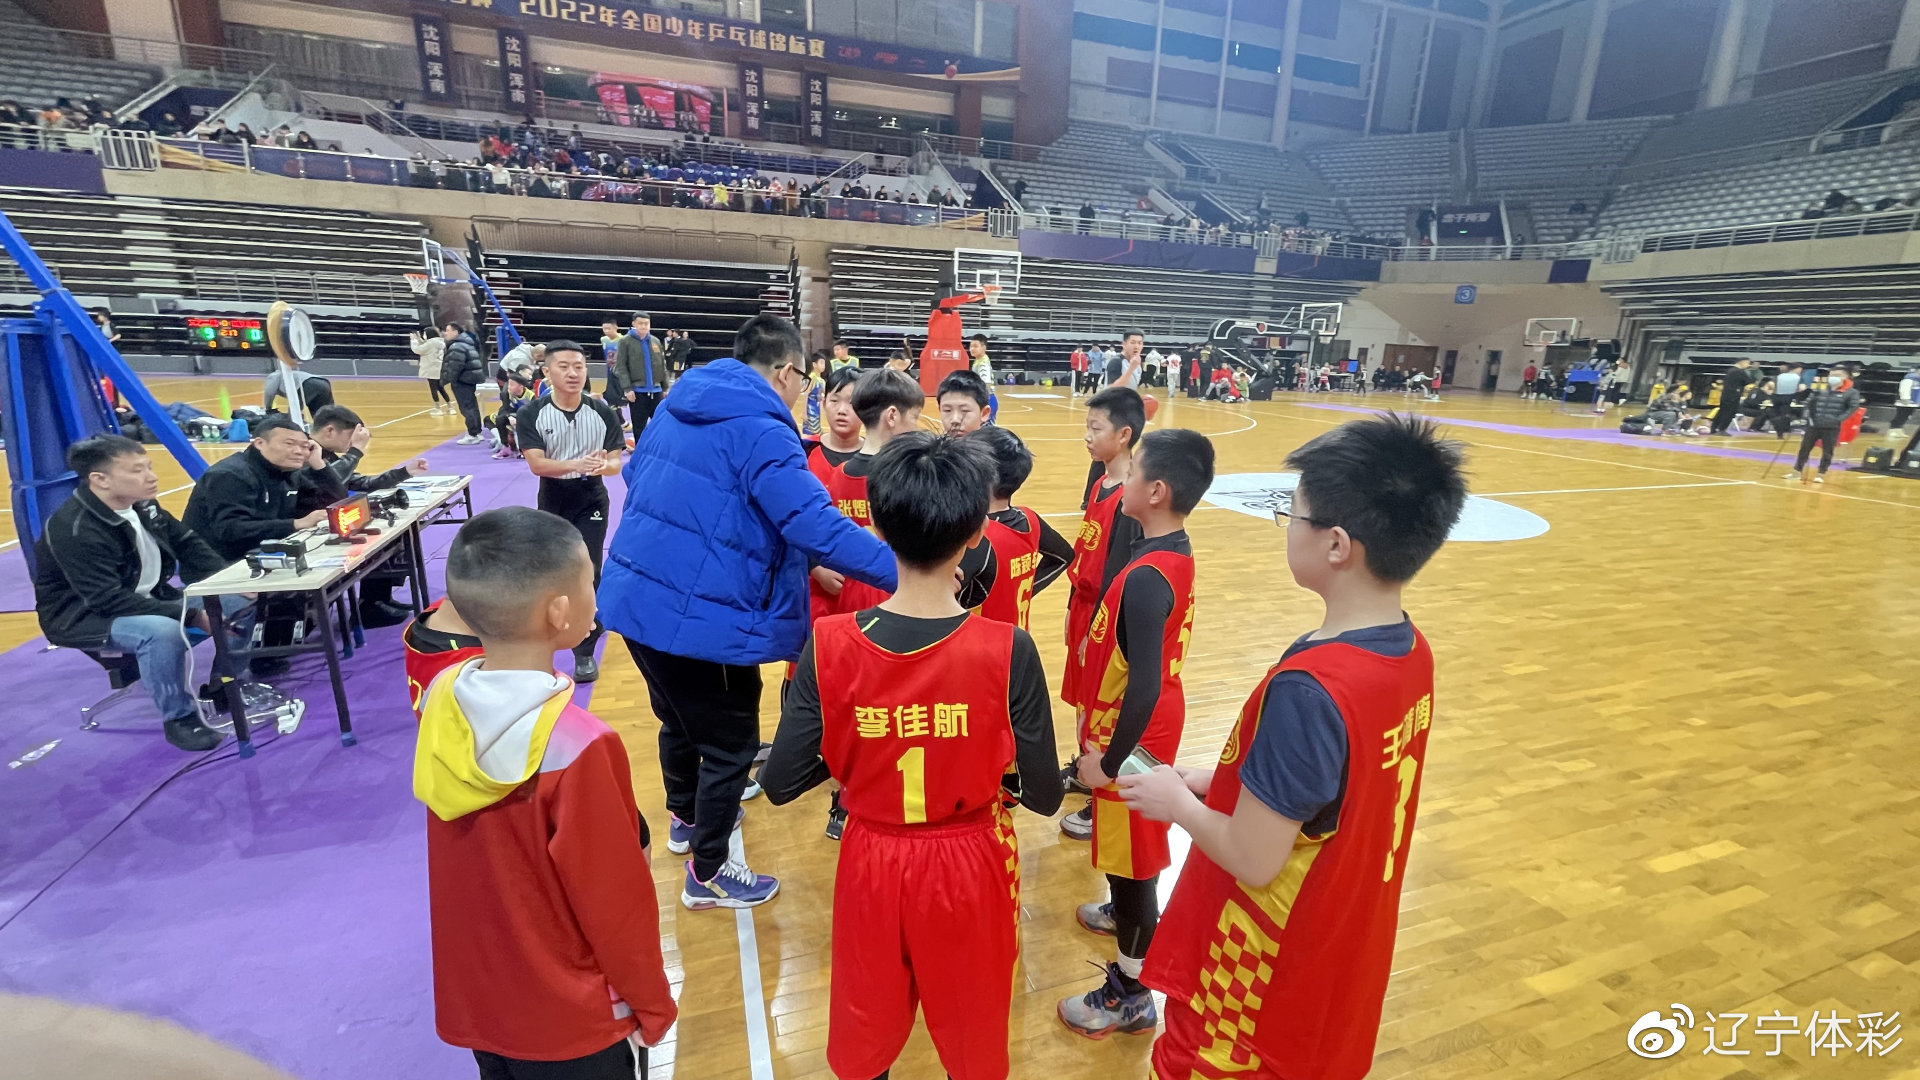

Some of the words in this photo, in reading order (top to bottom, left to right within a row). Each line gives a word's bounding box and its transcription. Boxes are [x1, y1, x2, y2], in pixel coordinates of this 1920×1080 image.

[520, 0, 825, 58] 2022年全国少年乒乓球锦标赛
[745, 69, 759, 130] 沈阳浑南
[810, 79, 823, 138] 沈阳浑南
[838, 499, 870, 518] 张煜
[855, 703, 968, 738] 李佳航
[897, 747, 926, 824] 1
